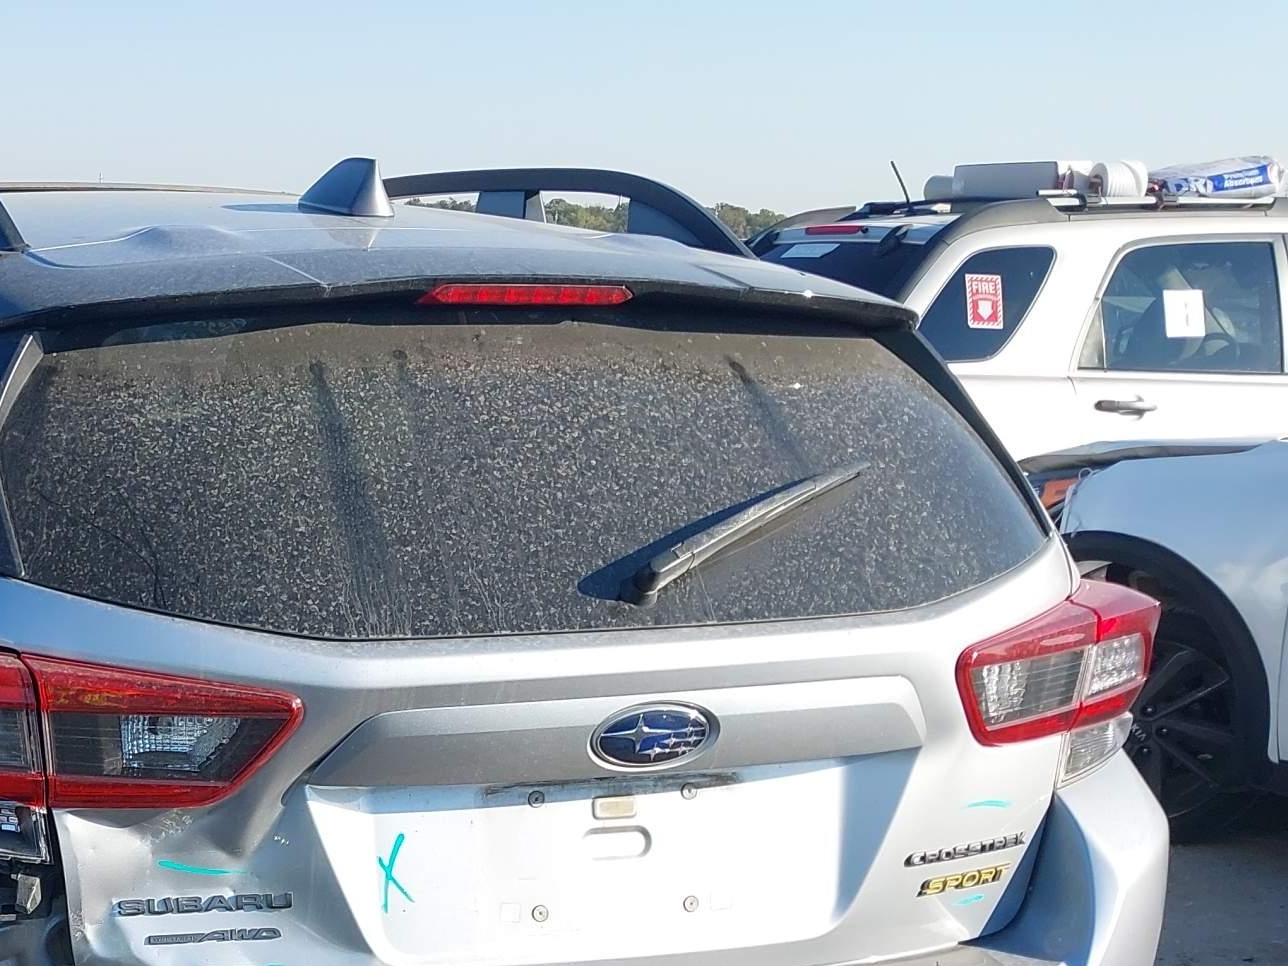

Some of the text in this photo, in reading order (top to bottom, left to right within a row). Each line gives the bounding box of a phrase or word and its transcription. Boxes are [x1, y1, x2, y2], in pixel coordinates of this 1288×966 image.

[972, 280, 996, 294] FIRE
[904, 832, 1026, 868] CROSSTREK
[916, 862, 1011, 897] SPORT
[113, 892, 294, 917] SUBARU
[199, 927, 282, 944] AWD
